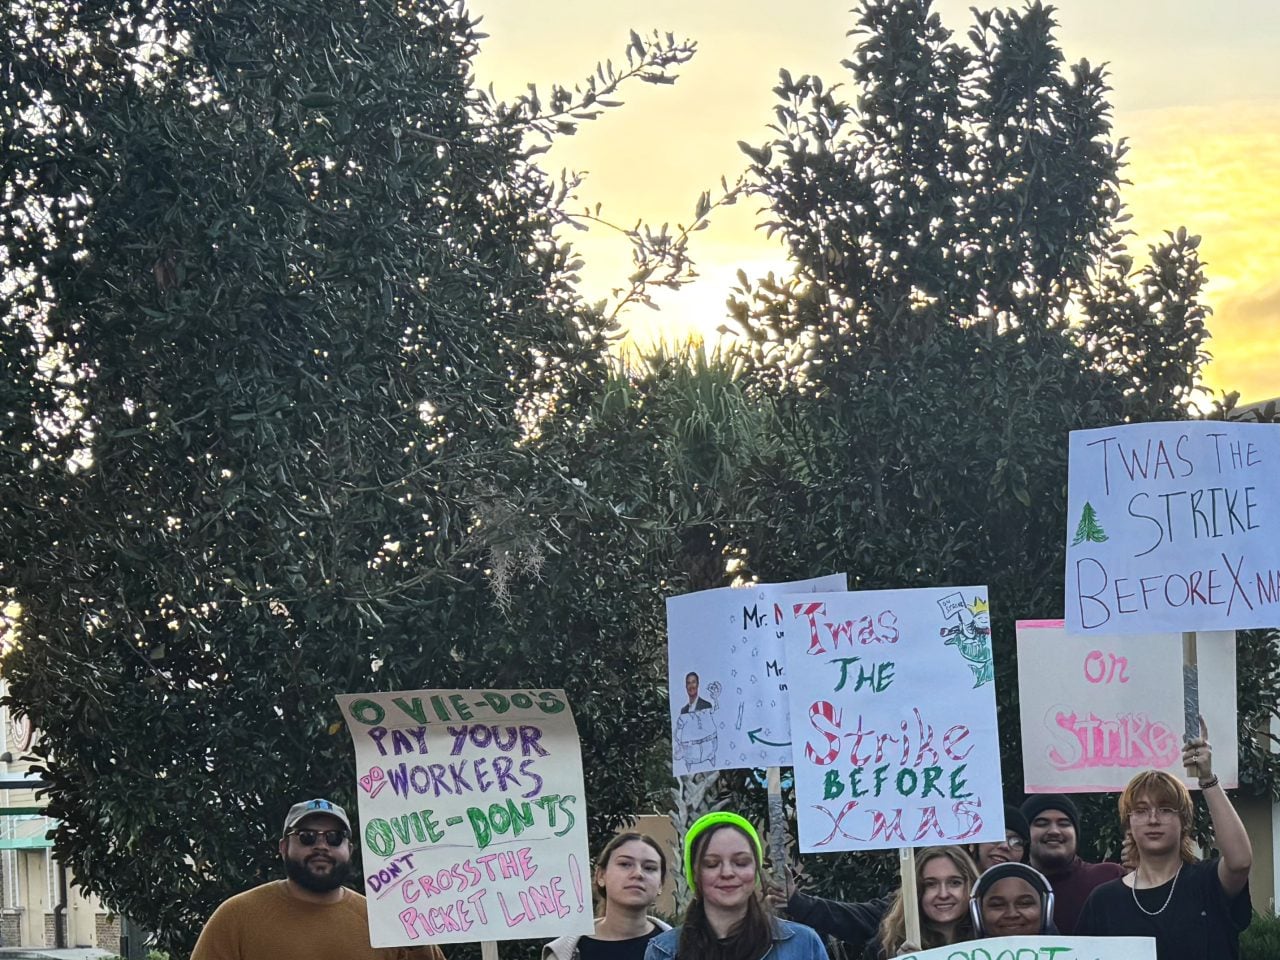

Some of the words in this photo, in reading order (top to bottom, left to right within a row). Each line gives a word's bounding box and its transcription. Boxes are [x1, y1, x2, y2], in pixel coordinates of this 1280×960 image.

[1087, 435, 1194, 495] TWAS
[1207, 433, 1262, 474] THE
[1128, 486, 1261, 557] STRIKE
[1076, 557, 1224, 629] BEFORE
[824, 656, 896, 694] THE
[367, 726, 429, 756] PAY
[446, 723, 551, 757] YOUR
[804, 700, 976, 767] Strike
[358, 766, 385, 793] DO
[387, 756, 544, 800] WORKERS
[822, 763, 973, 801] BEFORE
[366, 852, 416, 893] DON'T
[398, 889, 488, 941] PICKET
